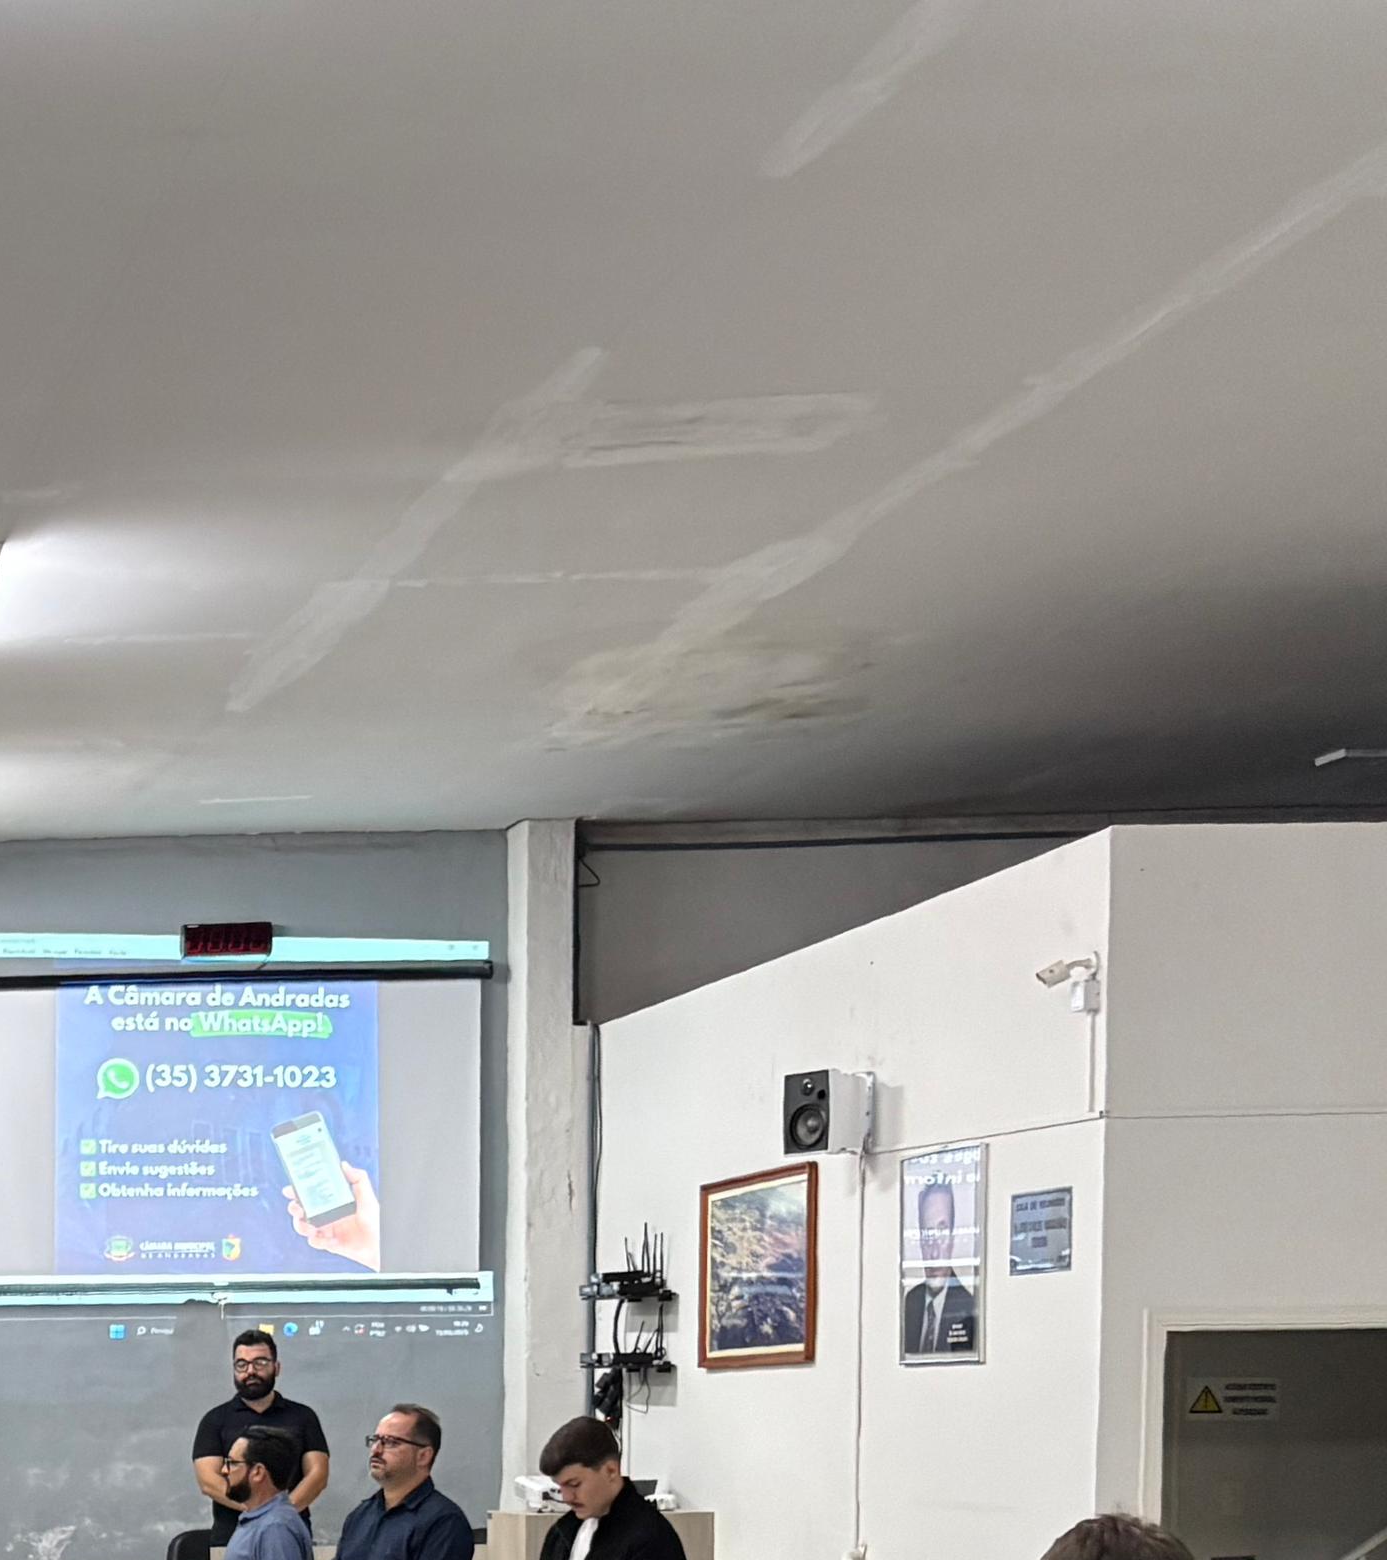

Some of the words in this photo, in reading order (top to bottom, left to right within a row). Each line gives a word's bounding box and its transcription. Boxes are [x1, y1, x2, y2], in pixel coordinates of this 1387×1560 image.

[84, 986, 103, 1005] A
[108, 985, 201, 1006] Câmara
[206, 987, 233, 1006] de
[239, 987, 350, 1008] Andradas
[111, 1012, 159, 1031] está
[165, 1015, 193, 1031] no
[199, 1011, 324, 1037] WhatsApp!
[146, 1063, 197, 1092] (35)
[203, 1064, 337, 1088] 3731-1023
[99, 1139, 128, 1153] Tire
[131, 1142, 165, 1153] suas
[167, 1139, 227, 1153] dúvidas
[98, 1161, 139, 1175] Envie
[142, 1161, 215, 1179] sugestões
[98, 1183, 164, 1198] Obtenha
[167, 1183, 259, 1200] informações
